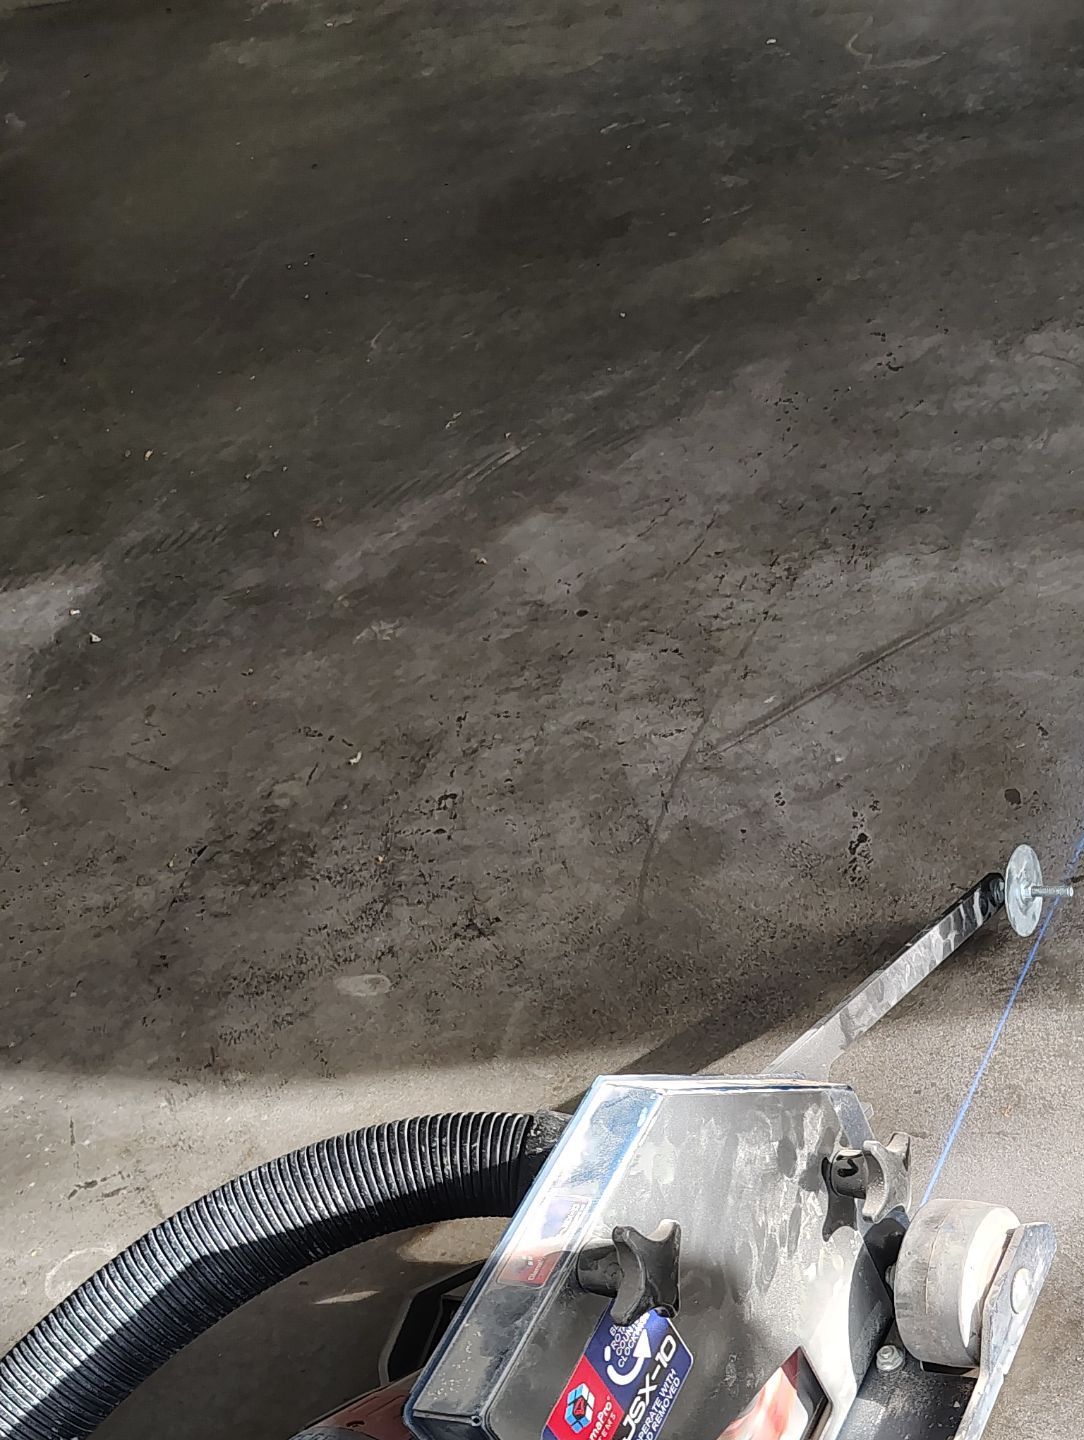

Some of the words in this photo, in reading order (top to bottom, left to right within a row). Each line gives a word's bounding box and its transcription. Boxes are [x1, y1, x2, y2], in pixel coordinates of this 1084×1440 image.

[616, 1320, 643, 1356] COUN
[659, 1368, 677, 1397] WITH
[651, 1376, 681, 1432] REMOVED
